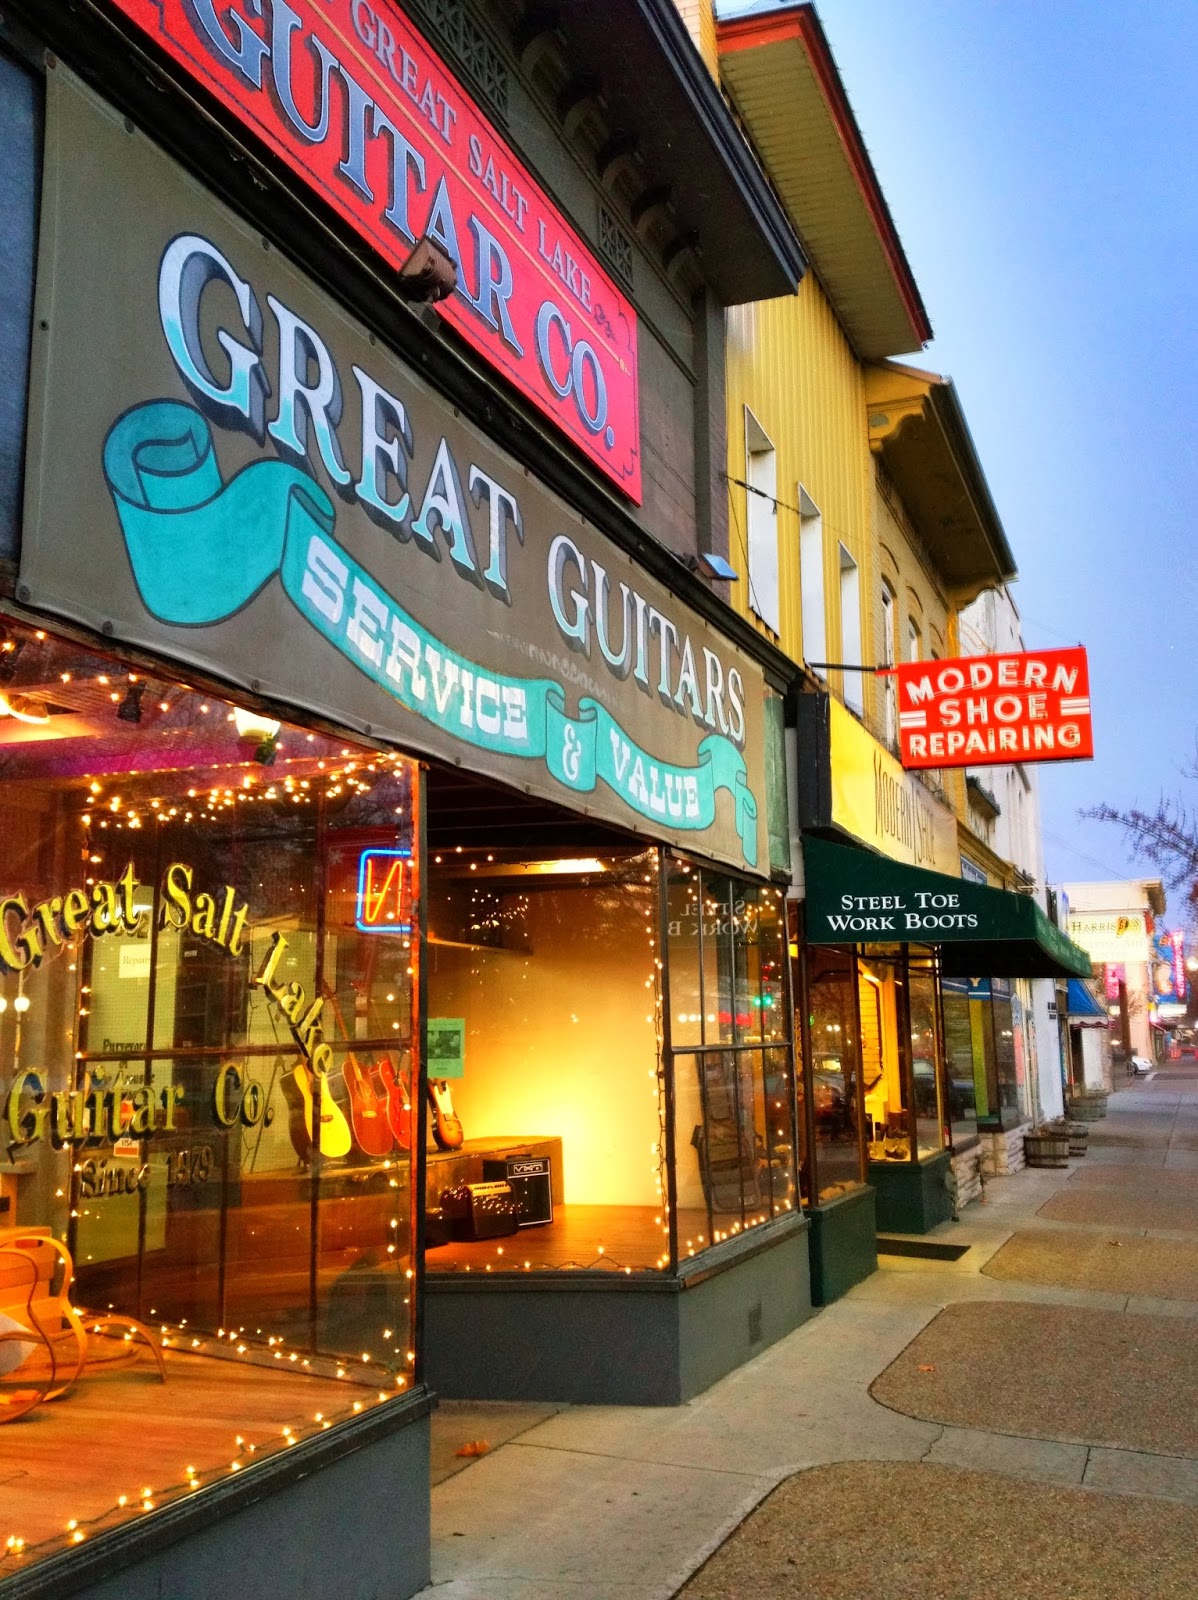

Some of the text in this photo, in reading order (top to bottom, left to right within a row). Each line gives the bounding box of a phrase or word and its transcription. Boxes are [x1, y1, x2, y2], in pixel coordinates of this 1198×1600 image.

[350, 0, 593, 314] GREAT SALT LAKE
[189, 0, 616, 448] GUITAR CO.
[157, 232, 747, 744] GREAT GUITARS
[301, 534, 700, 821] SERVICE & VALUE
[905, 659, 1079, 706] MODERN
[938, 692, 1048, 728] SHOE
[908, 722, 1081, 759] REPAIRING
[873, 749, 912, 850] MODERN
[826, 912, 978, 931] WORK BOOTS
[841, 892, 960, 910] STEEL TOE
[1072, 921, 1116, 934] HARRIS
[0, 860, 139, 970] Great
[163, 861, 249, 958] Salt
[255, 930, 335, 1078] Lake
[8, 1062, 275, 1146] Guitar Co.
[80, 1156, 151, 1200] Since
